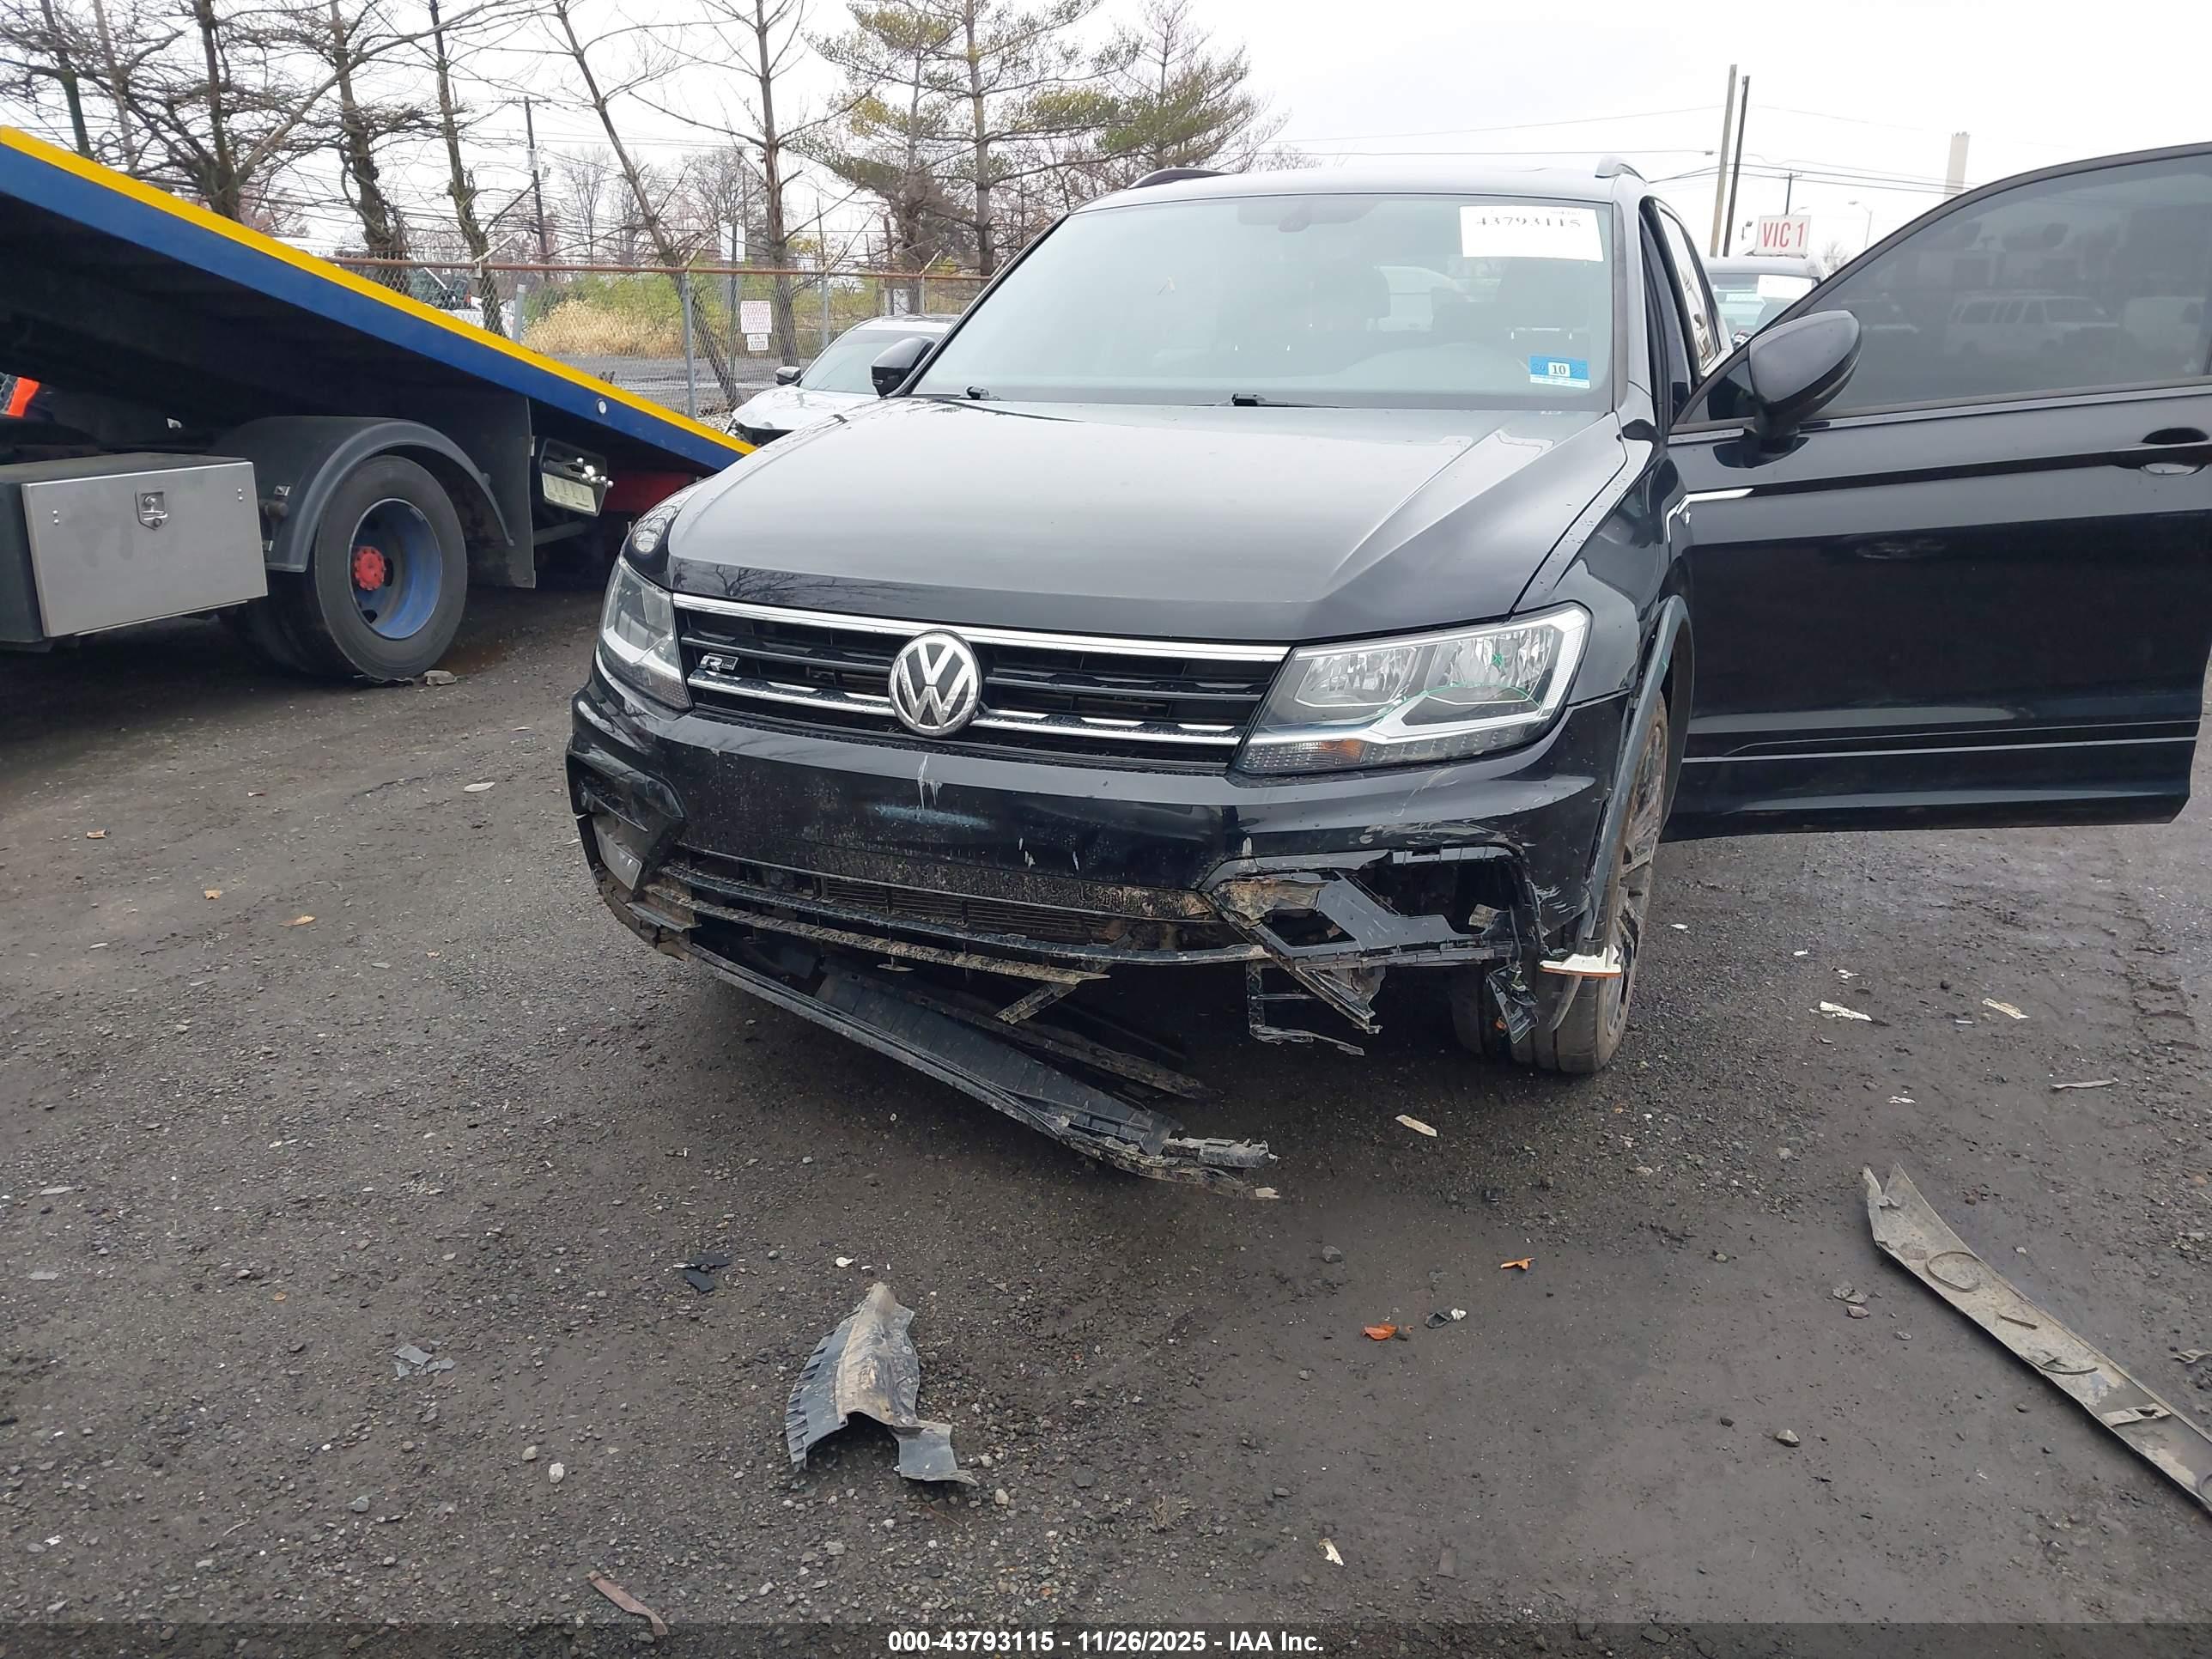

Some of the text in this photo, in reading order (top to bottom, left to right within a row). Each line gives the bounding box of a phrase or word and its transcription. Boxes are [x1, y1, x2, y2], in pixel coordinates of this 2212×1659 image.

[1763, 222, 1804, 247] VIC 1
[1552, 364, 1566, 374] 10
